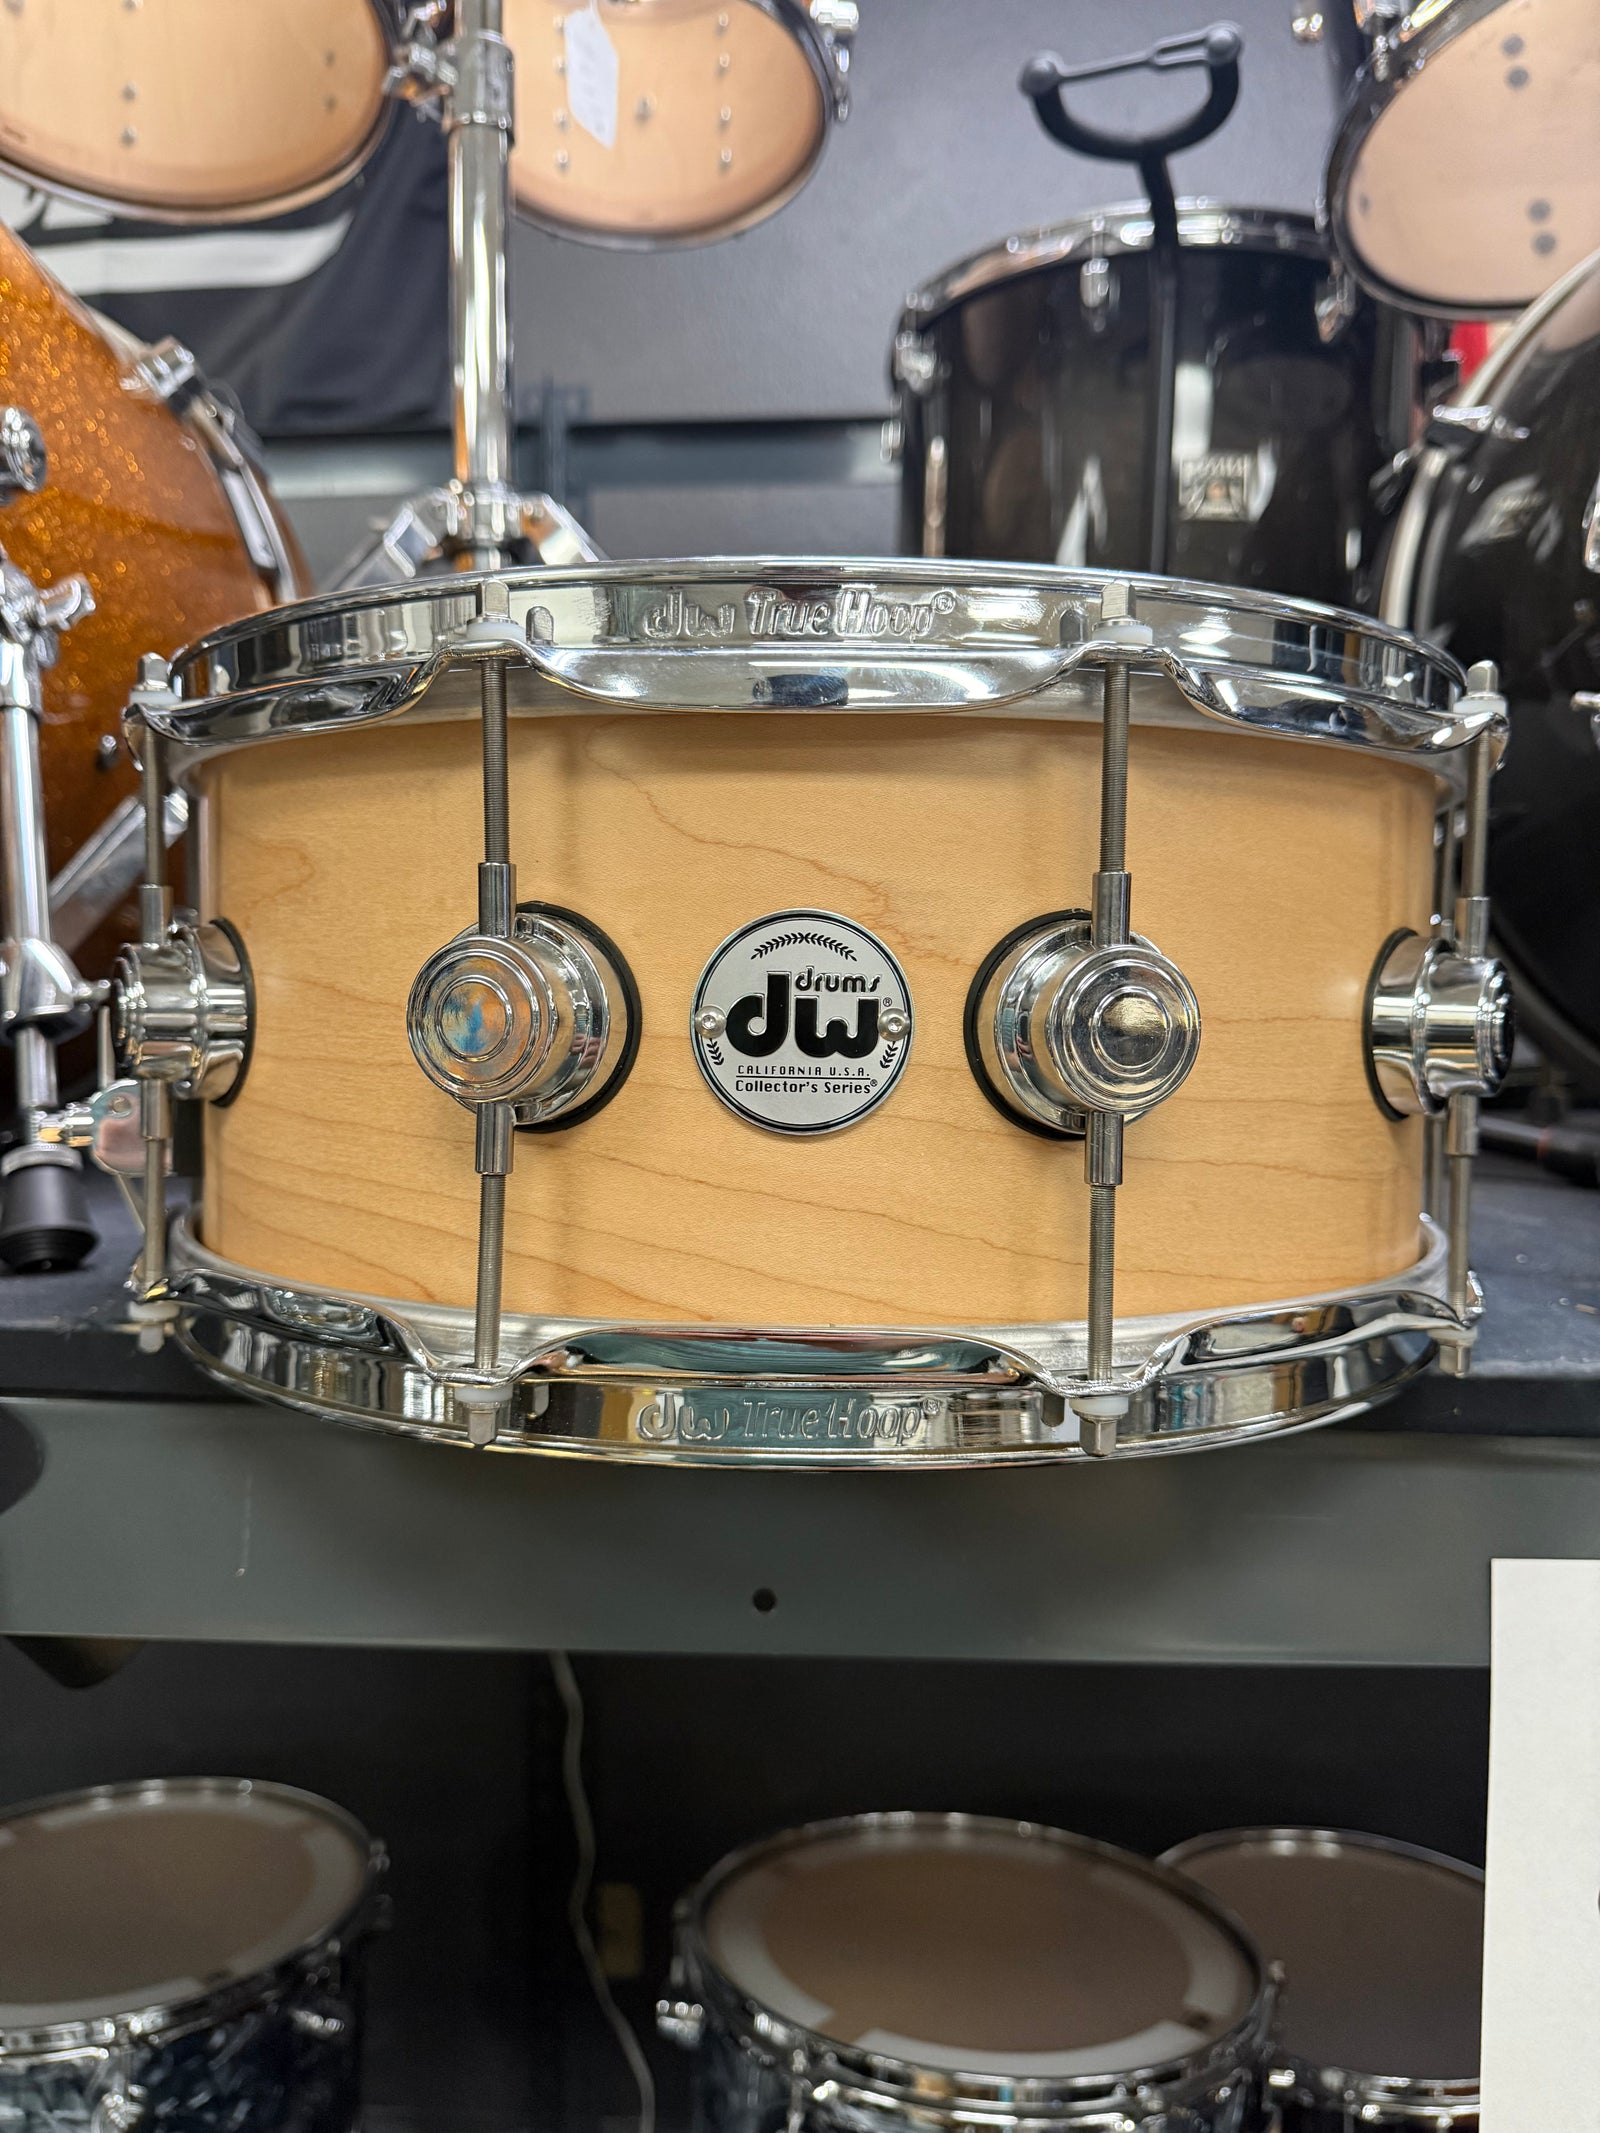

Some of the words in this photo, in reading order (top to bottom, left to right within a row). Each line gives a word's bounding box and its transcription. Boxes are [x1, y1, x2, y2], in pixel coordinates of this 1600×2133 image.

[644, 587, 736, 638] dw
[794, 965, 882, 993] drums
[737, 1065, 822, 1076] CALIFORNIA
[829, 1066, 870, 1077] U.S.A.
[735, 1080, 818, 1093] Collector's
[637, 1390, 730, 1441] dw
